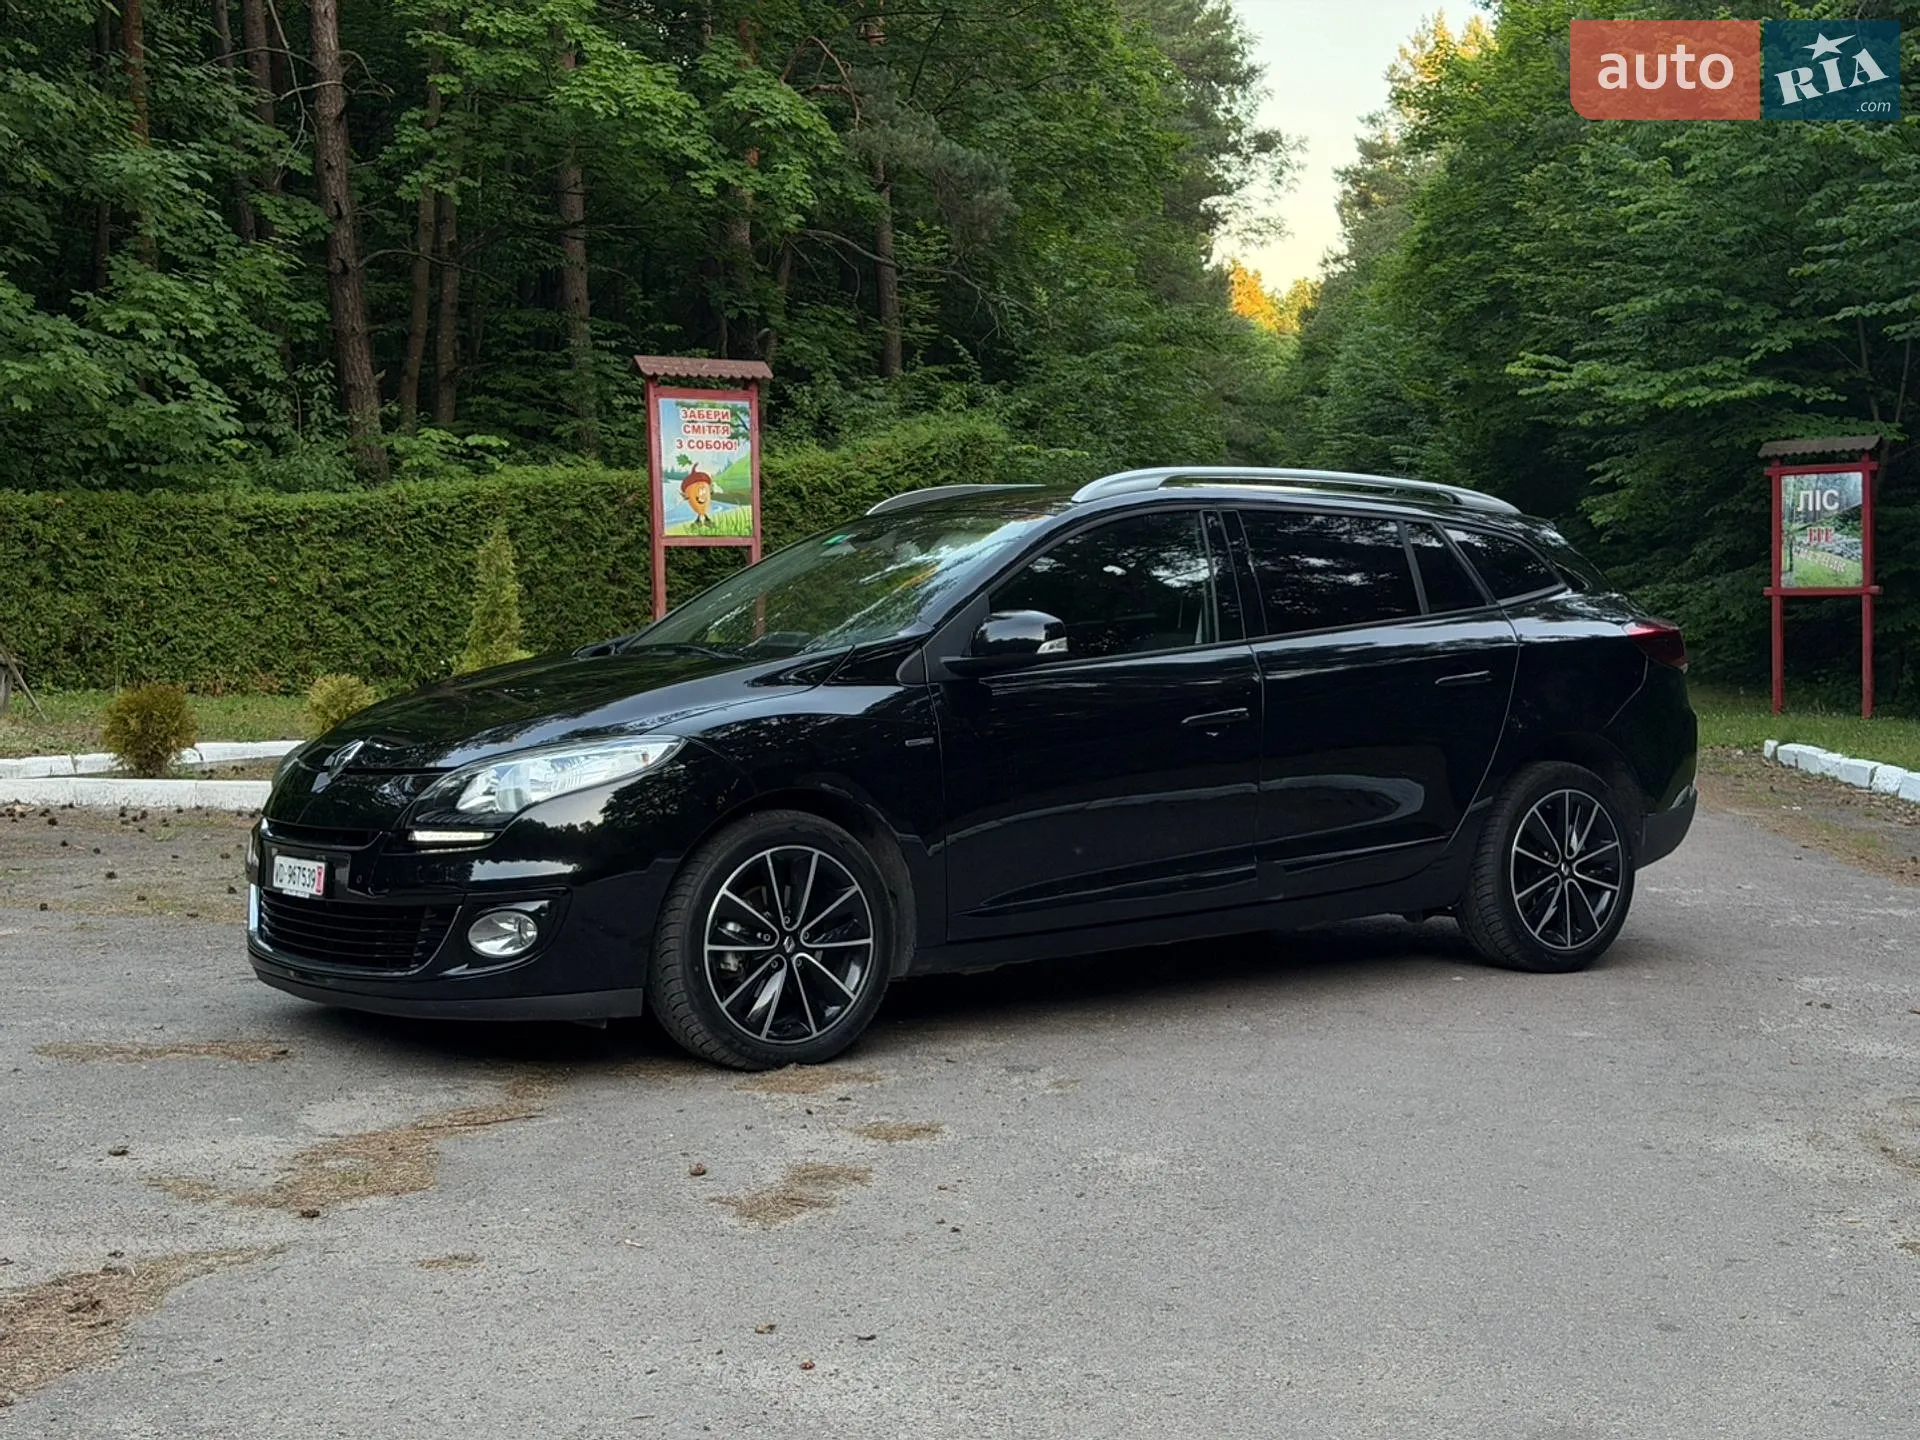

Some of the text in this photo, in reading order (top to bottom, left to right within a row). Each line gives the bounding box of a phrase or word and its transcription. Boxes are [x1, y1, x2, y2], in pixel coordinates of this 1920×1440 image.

[681, 409, 730, 420] ЗАБЕРИ
[683, 424, 730, 435] СМІТТЯ
[676, 439, 737, 451] З СОБОЮ!
[1798, 489, 1840, 511] ЛІС
